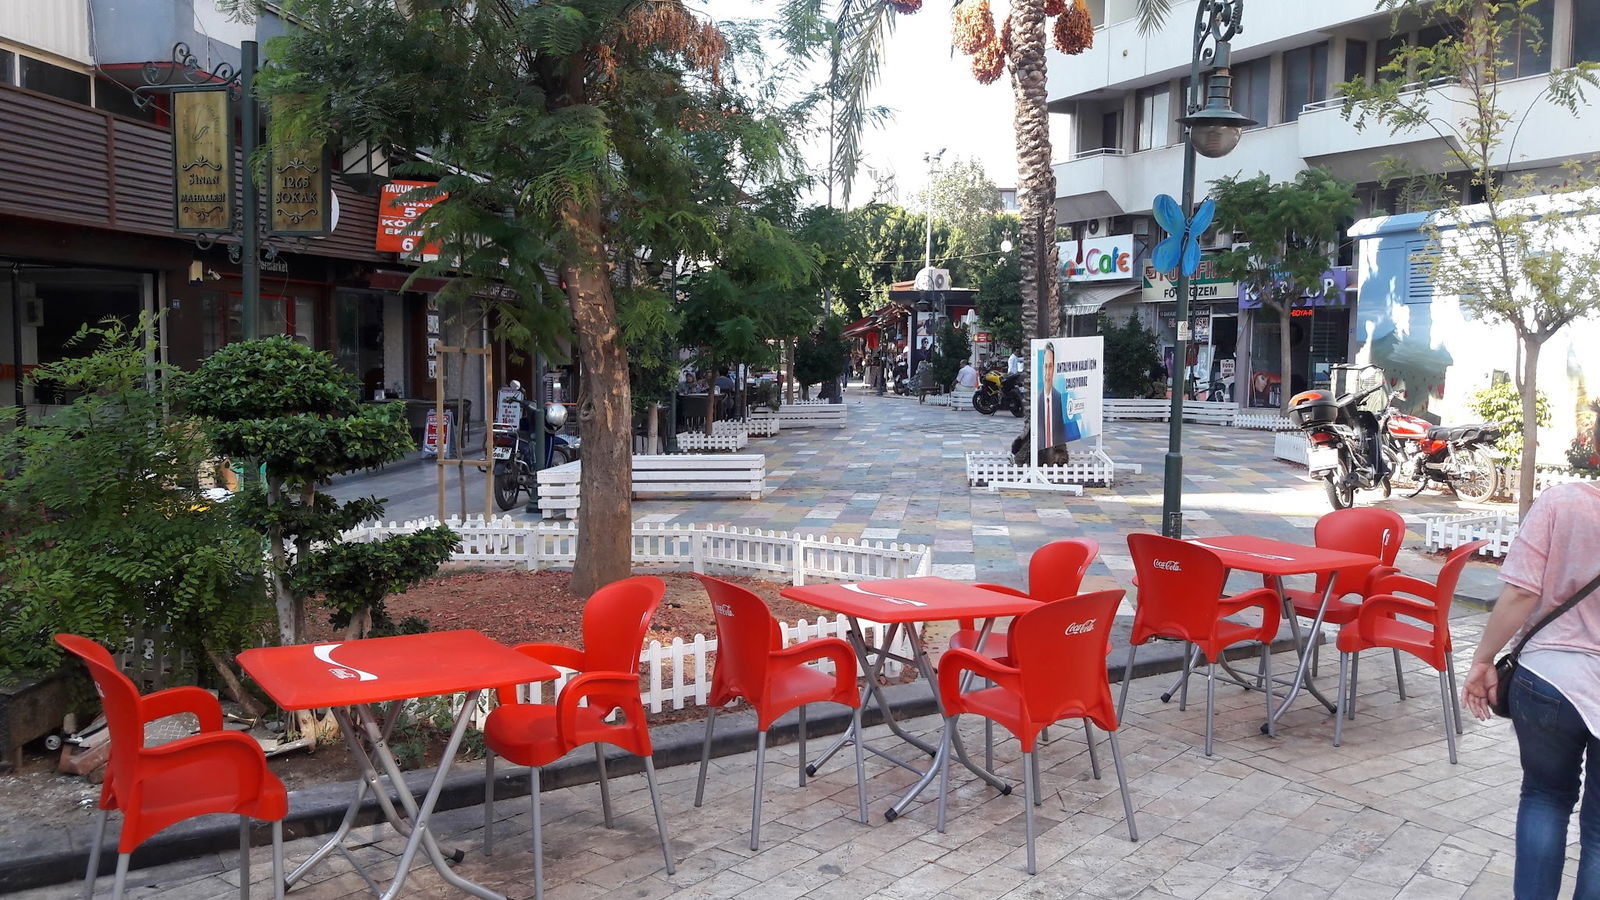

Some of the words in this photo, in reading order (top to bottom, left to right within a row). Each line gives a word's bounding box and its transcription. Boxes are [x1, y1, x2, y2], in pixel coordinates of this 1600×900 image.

[282, 176, 310, 190] 1265
[384, 183, 413, 194] TAVUK
[276, 192, 318, 204] SOKAK
[1153, 558, 1182, 571] Coca-Cola
[1064, 618, 1097, 635] Coca-Cola
